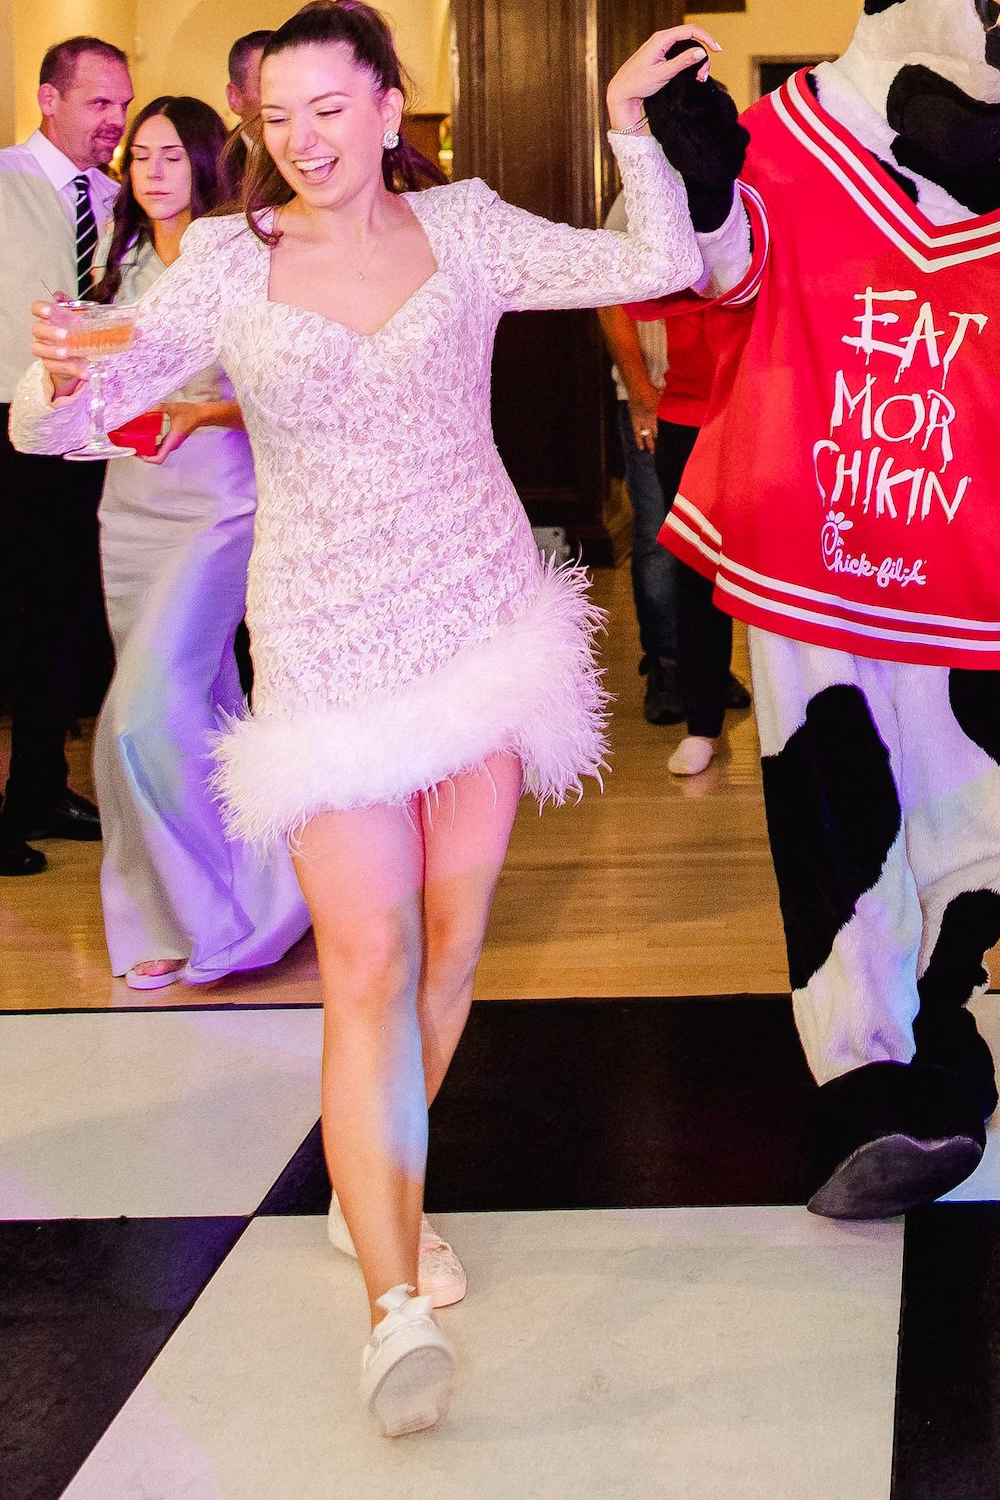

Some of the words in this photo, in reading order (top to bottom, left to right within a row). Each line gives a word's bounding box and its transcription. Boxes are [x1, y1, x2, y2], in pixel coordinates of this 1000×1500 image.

[841, 286, 989, 389] EAT
[829, 369, 956, 473] MOR
[812, 439, 966, 525] CHIKIN
[820, 518, 927, 588] Chick-fil-A
